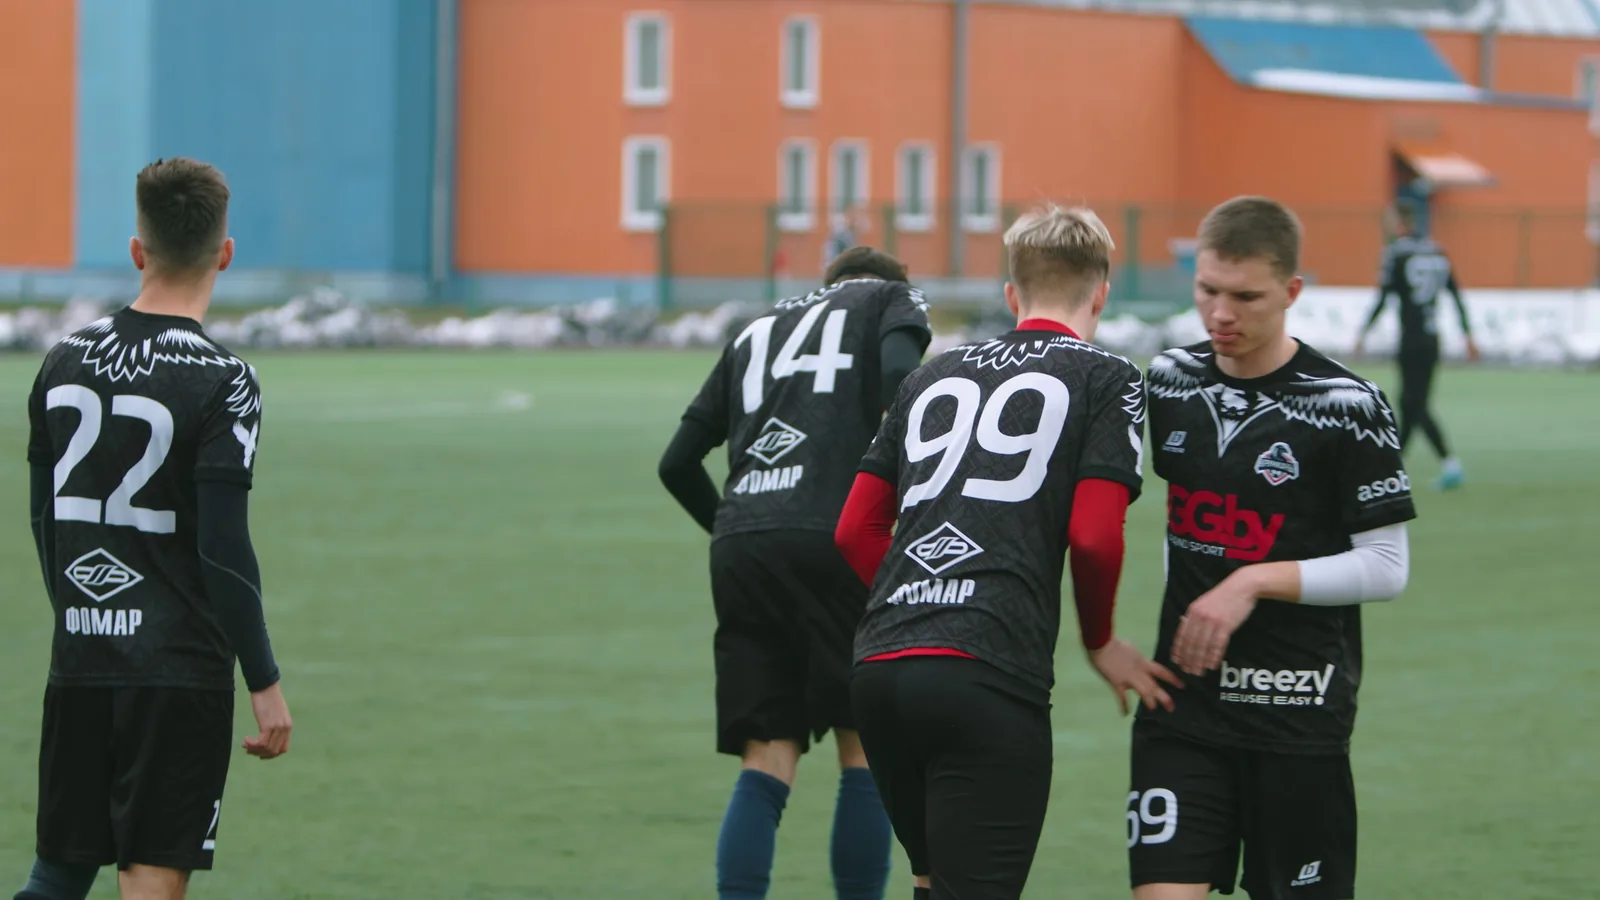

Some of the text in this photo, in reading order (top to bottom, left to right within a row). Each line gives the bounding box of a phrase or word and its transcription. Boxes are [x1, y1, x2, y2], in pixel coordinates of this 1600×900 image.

[734, 300, 853, 414] 14
[46, 384, 176, 533] 22
[901, 372, 1070, 513] 99
[1219, 691, 1271, 704] REUSE
[1126, 787, 1178, 848] 69
